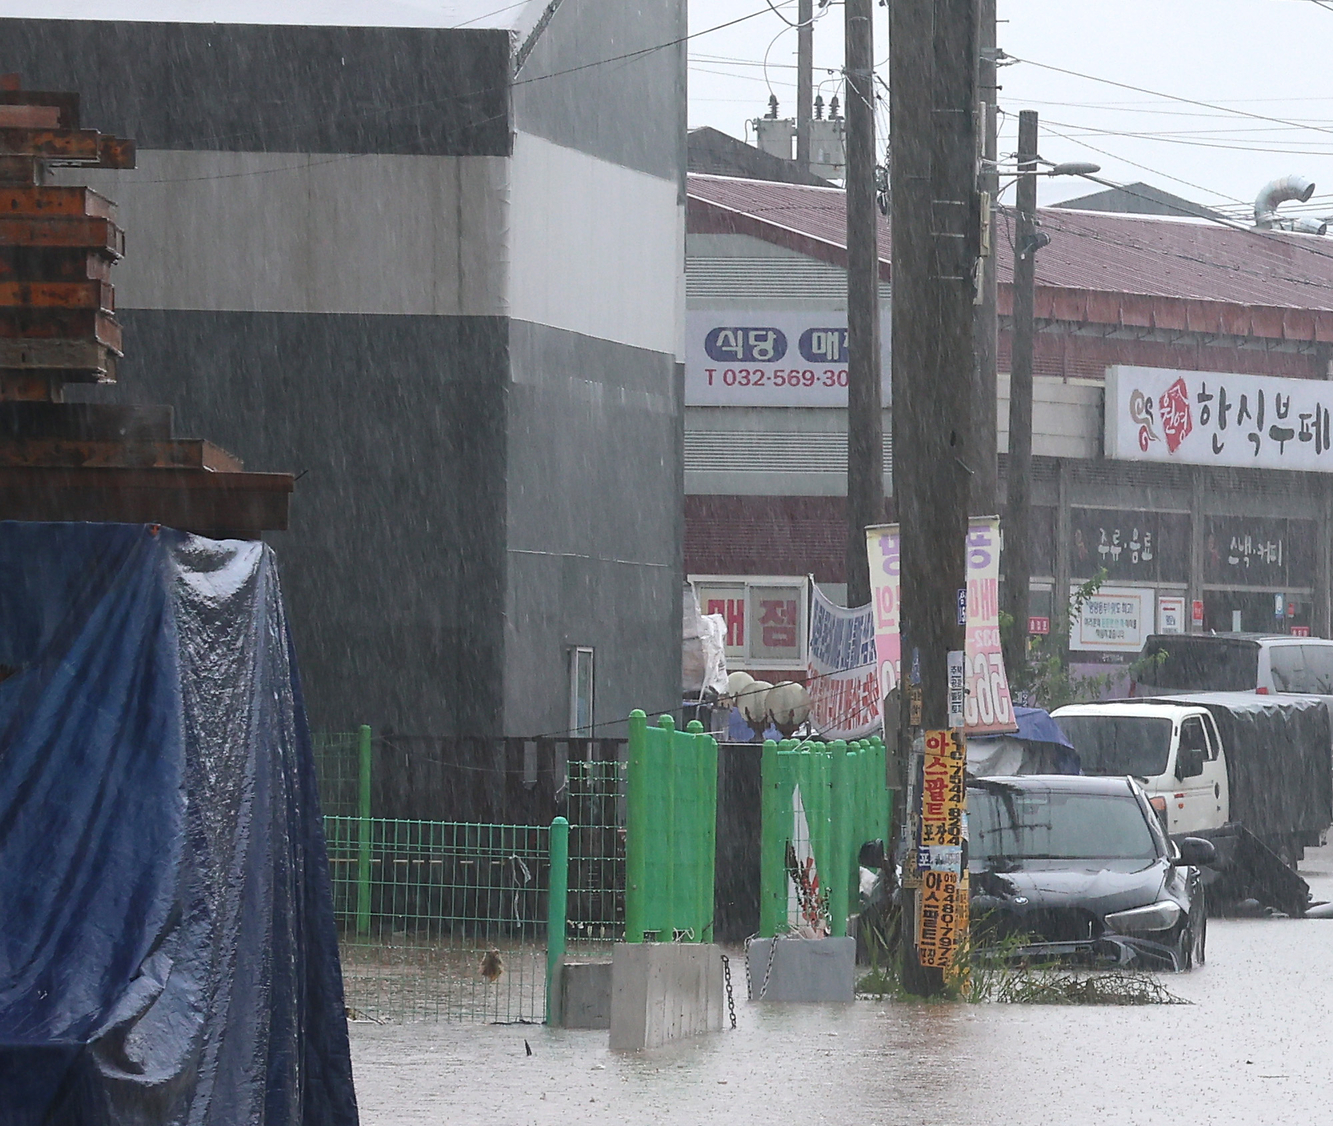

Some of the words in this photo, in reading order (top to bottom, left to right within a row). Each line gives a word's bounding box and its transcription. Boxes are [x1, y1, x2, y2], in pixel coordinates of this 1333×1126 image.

[716, 330, 776, 360] 식당
[812, 332, 849, 360] 매
[705, 369, 716, 386] T
[723, 369, 849, 387] 032·569·30
[1197, 381, 1331, 457] 한식부페
